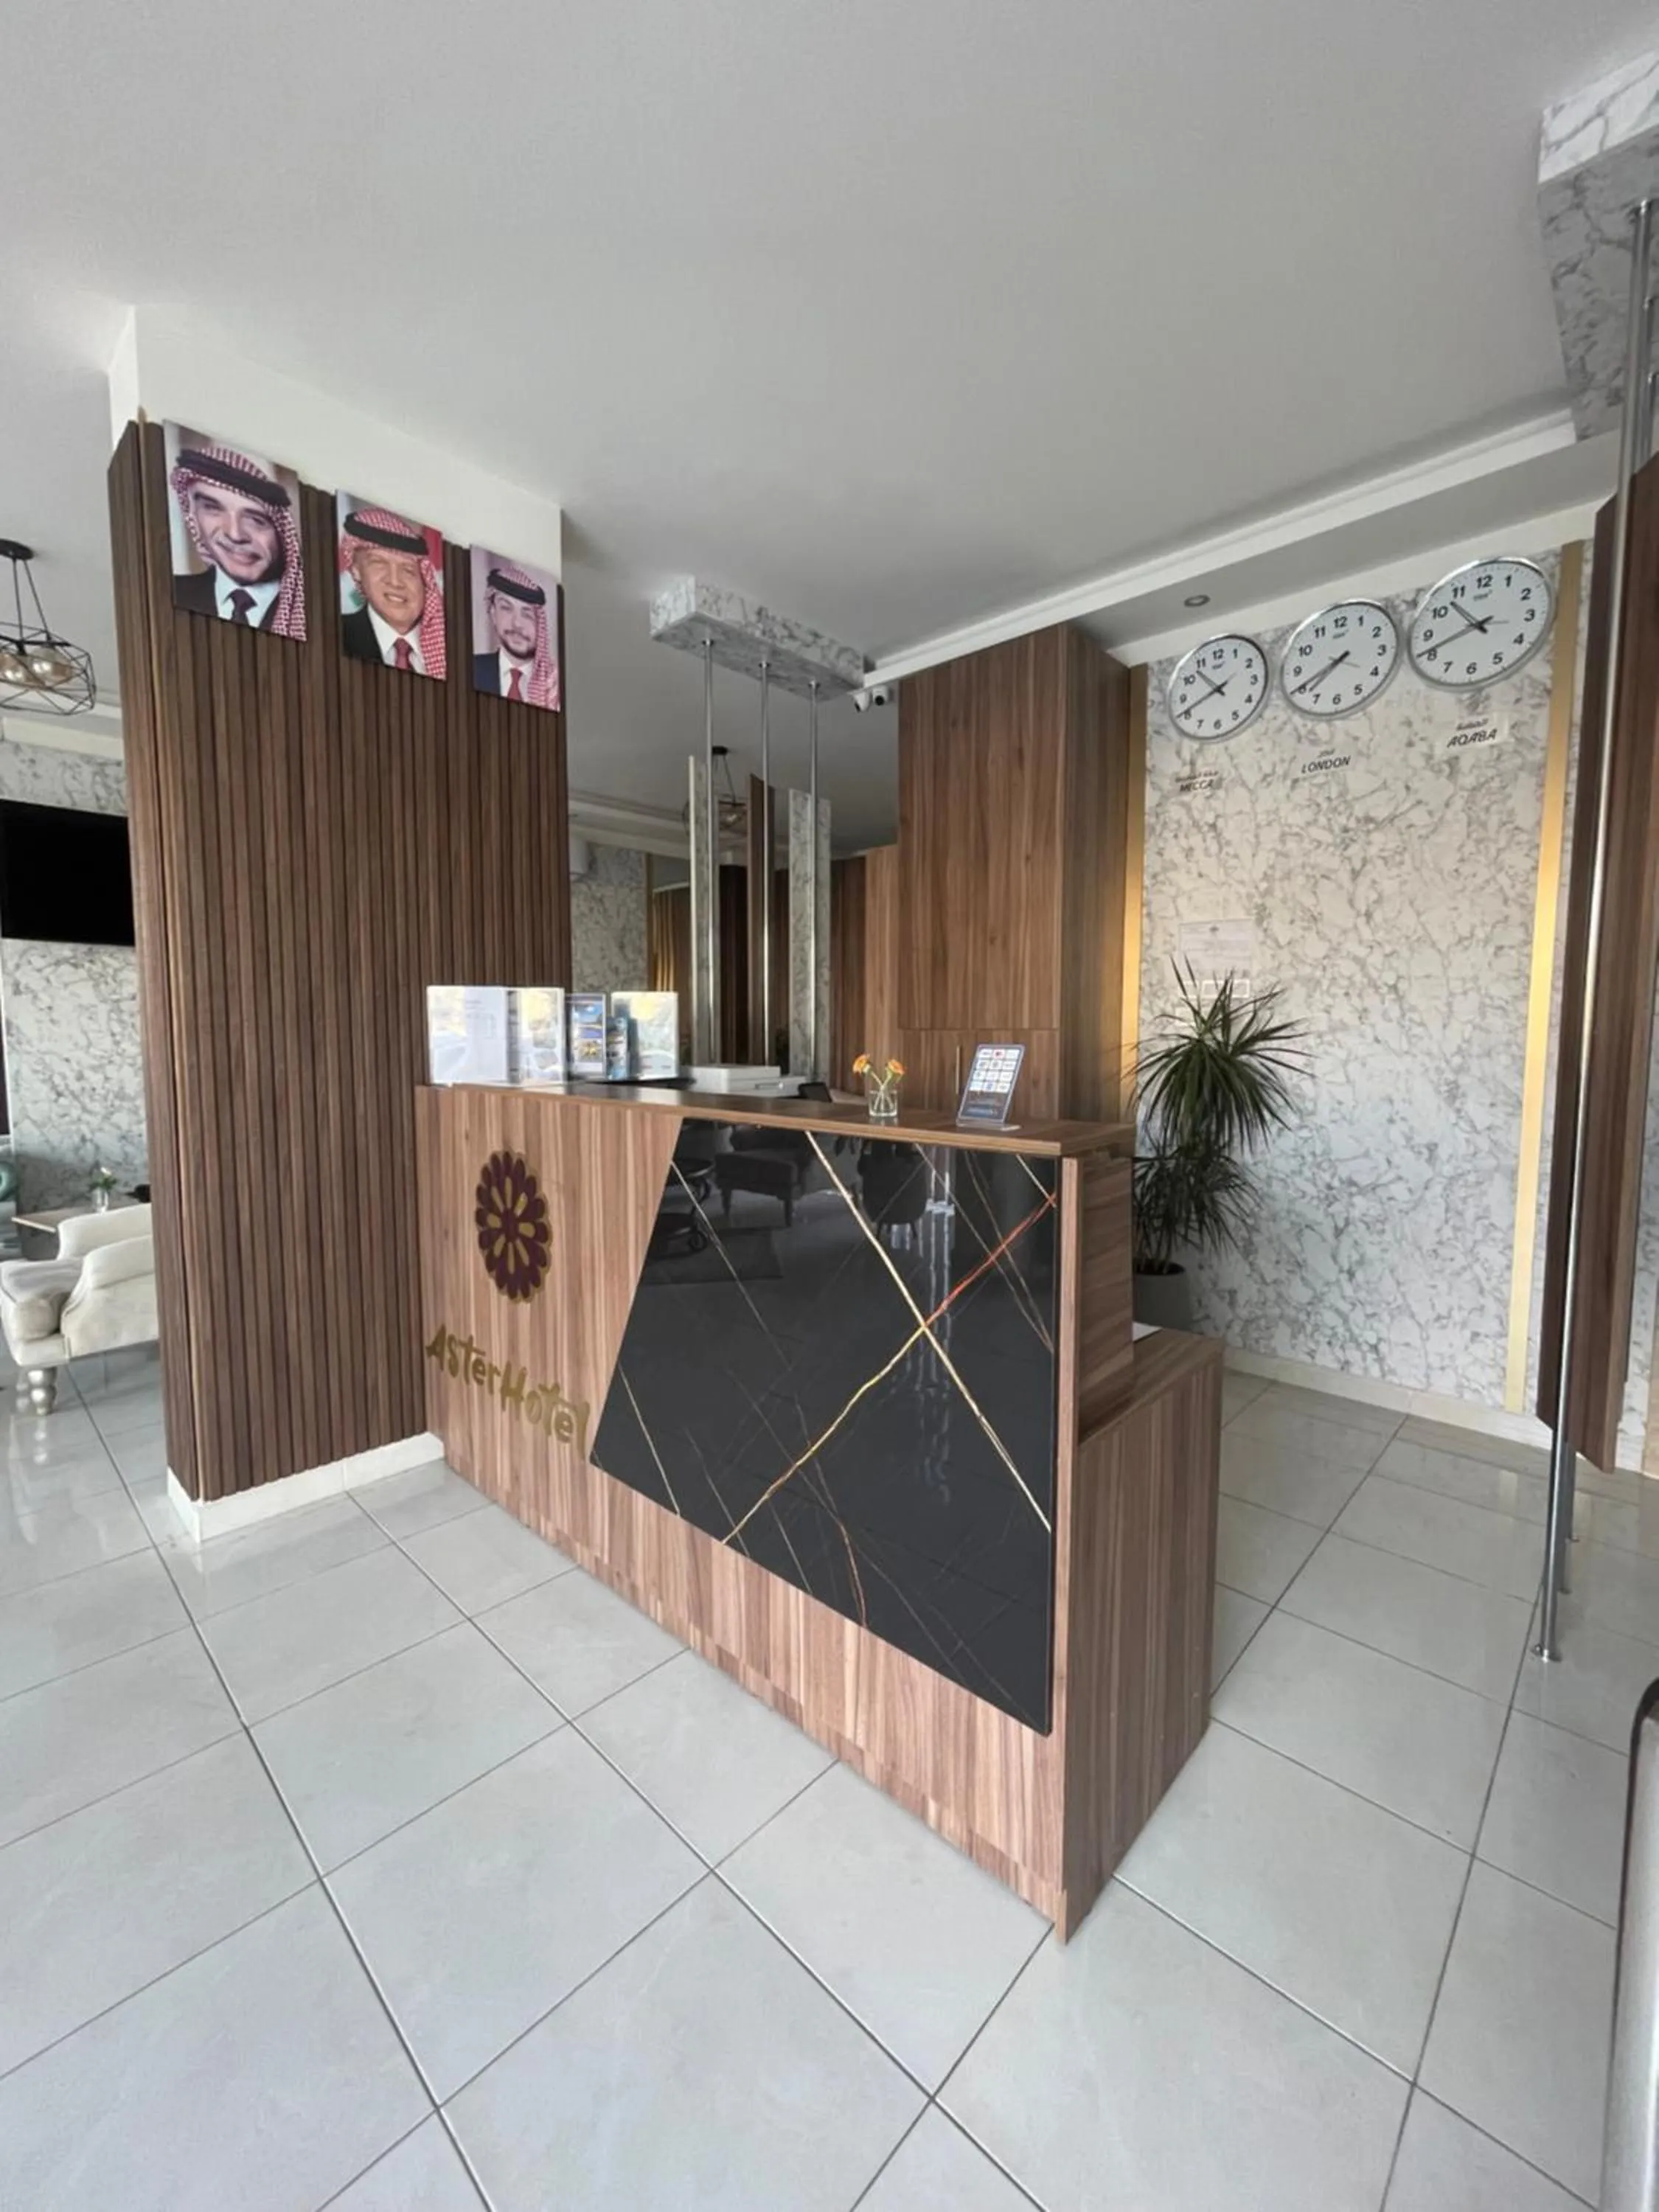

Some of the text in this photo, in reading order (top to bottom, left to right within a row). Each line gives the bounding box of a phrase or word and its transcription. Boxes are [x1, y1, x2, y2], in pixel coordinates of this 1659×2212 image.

[1476, 574, 1493, 589] 12
[1505, 574, 1512, 588] 1
[1452, 585, 1466, 599] 11
[1520, 588, 1531, 601] 2
[1432, 605, 1449, 619] 10
[1523, 608, 1535, 622] 3
[1333, 616, 1348, 627] 12
[1358, 616, 1364, 626] 1
[1315, 626, 1326, 639] 11
[1372, 626, 1381, 639] 2
[1423, 629, 1433, 641] 9
[1513, 633, 1525, 645] 4
[1212, 648, 1224, 660] 12
[1233, 648, 1238, 659] 1
[1298, 644, 1312, 657] 10
[1377, 644, 1386, 656] 3
[1196, 657, 1206, 669] 11
[1244, 658, 1253, 669] 2
[1492, 652, 1504, 665] 5
[1293, 665, 1302, 678] 9
[1369, 665, 1379, 677] 4
[1443, 661, 1453, 673] 7
[1466, 661, 1478, 675] 6
[1183, 674, 1195, 686] 10
[1250, 673, 1258, 686] 3
[1354, 684, 1363, 695] 5
[1180, 693, 1187, 704] 9
[1244, 694, 1253, 703] 4
[1312, 693, 1321, 705] 7
[1332, 693, 1341, 705] 6
[1231, 709, 1239, 721] 5
[1197, 719, 1204, 729] 7
[1213, 719, 1222, 730] 6
[1447, 728, 1498, 748] AQABA
[1301, 755, 1351, 773] LONDON
